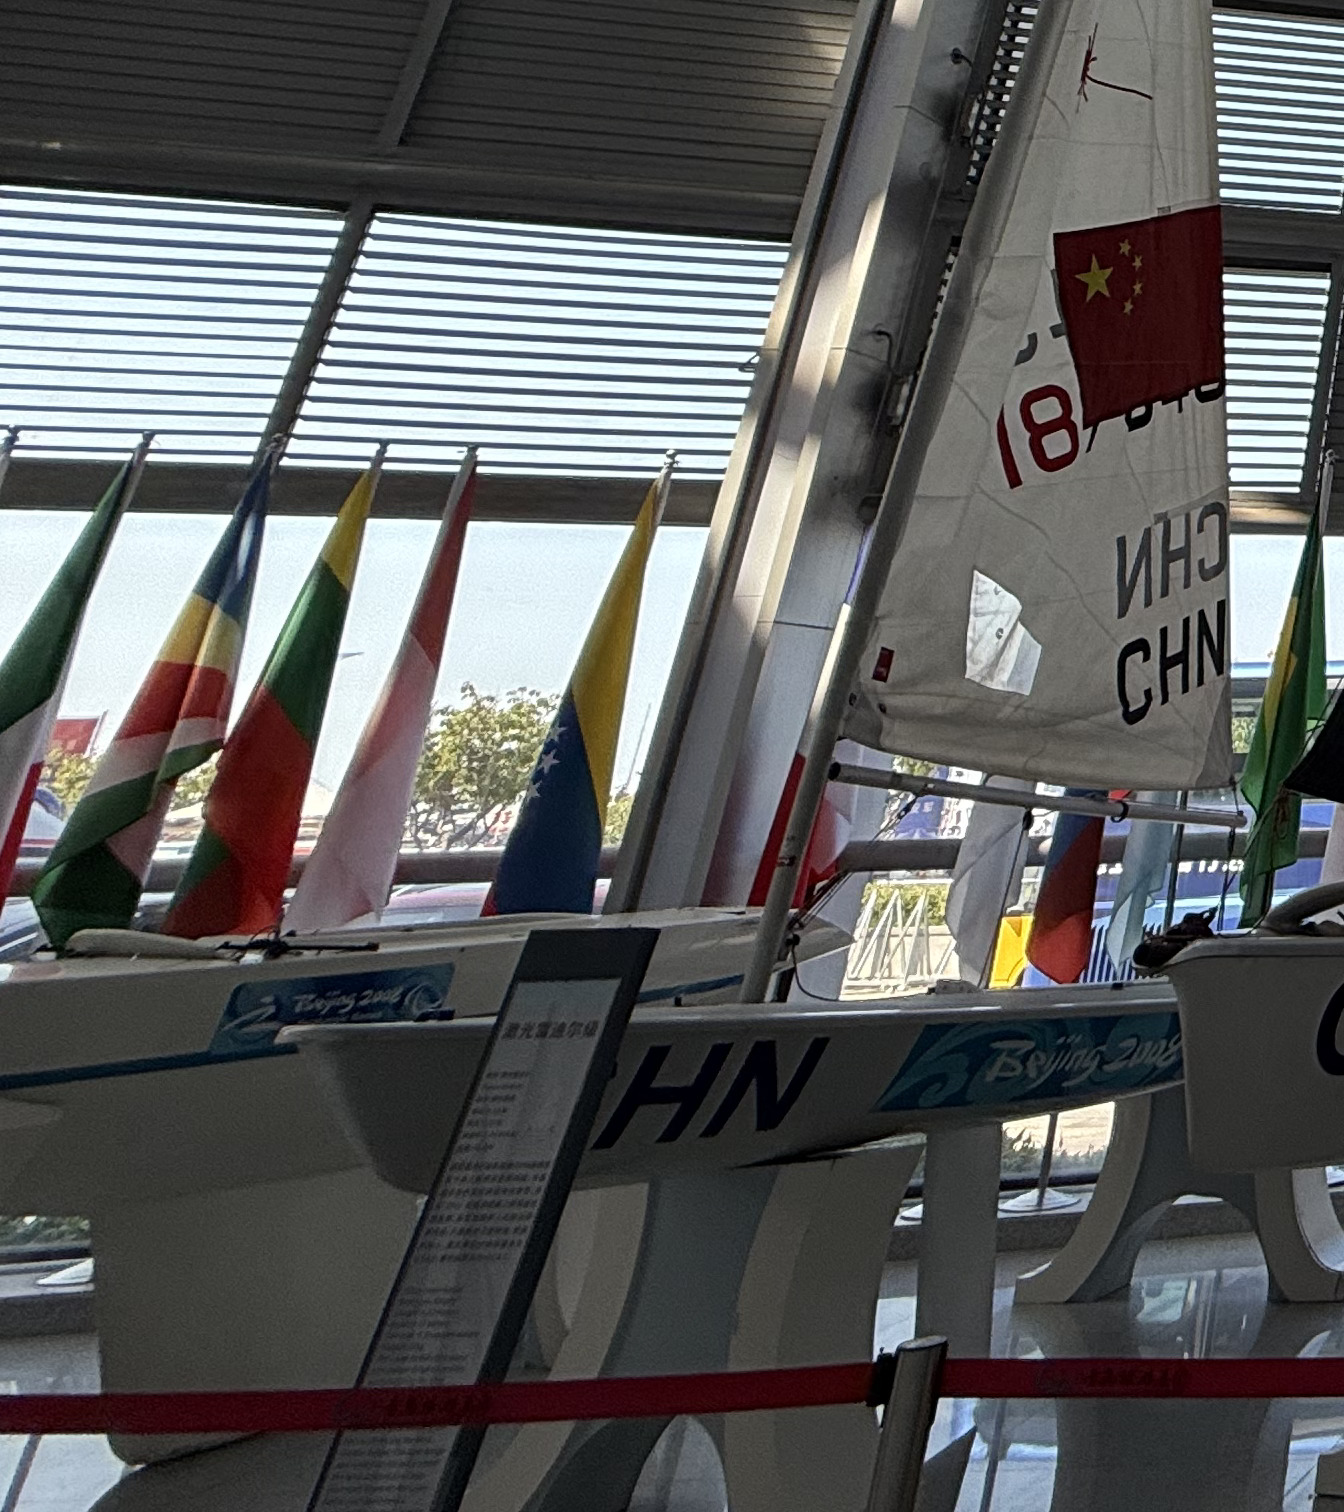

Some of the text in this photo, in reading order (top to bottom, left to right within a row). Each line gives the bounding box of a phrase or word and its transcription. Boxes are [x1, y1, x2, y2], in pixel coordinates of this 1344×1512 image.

[1116, 601, 1226, 725] CHN
[293, 991, 357, 1014] Beijing
[593, 1036, 828, 1150] HN
[985, 1032, 1182, 1086] Beijing 2008
